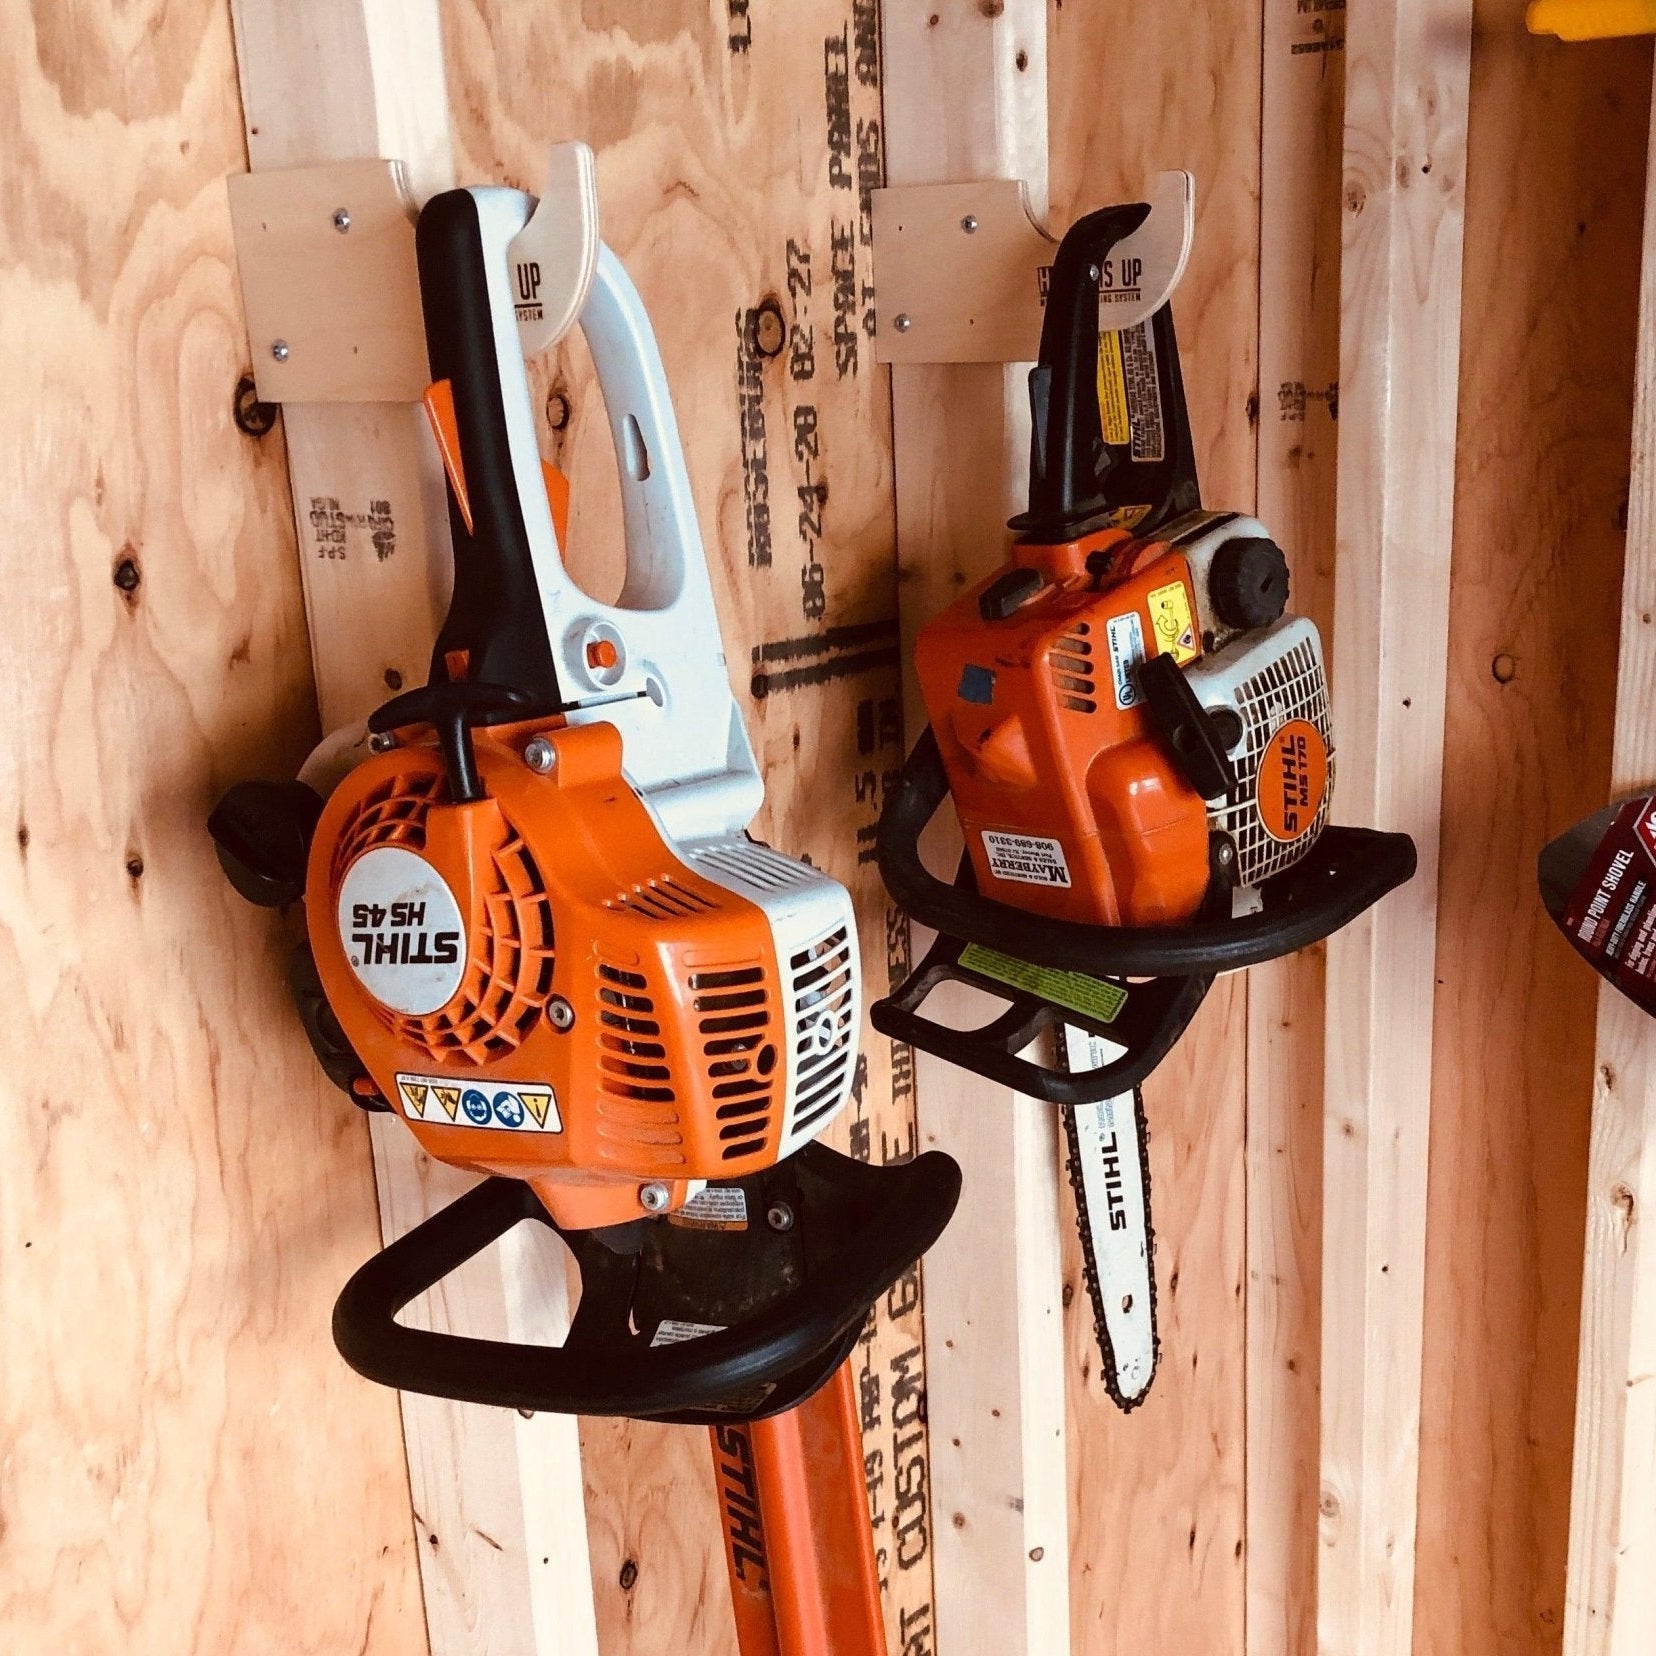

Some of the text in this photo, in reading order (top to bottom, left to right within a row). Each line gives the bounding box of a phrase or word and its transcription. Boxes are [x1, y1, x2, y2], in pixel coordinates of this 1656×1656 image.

[825, 20, 859, 380] SPACE PANEL
[517, 262, 541, 300] UP
[1122, 258, 1142, 287] UP
[1114, 291, 1141, 302] SYSTEM
[1109, 626, 1119, 652] STIHL
[1281, 734, 1298, 833] STIHL
[1296, 735, 1309, 807] MS 170
[988, 835, 1054, 851] 908-689-3310
[991, 858, 1068, 884] MAYBERRY
[1587, 888, 1608, 923] POINT
[1602, 849, 1634, 891] SHOVEL
[1628, 880, 1647, 904] HANDLE
[352, 902, 426, 928] HS 45
[351, 932, 460, 965] STIHL
[1101, 1132, 1127, 1231] STIHL
[891, 1344, 928, 1571] CUSTOM
[715, 1424, 769, 1582] STIHL
